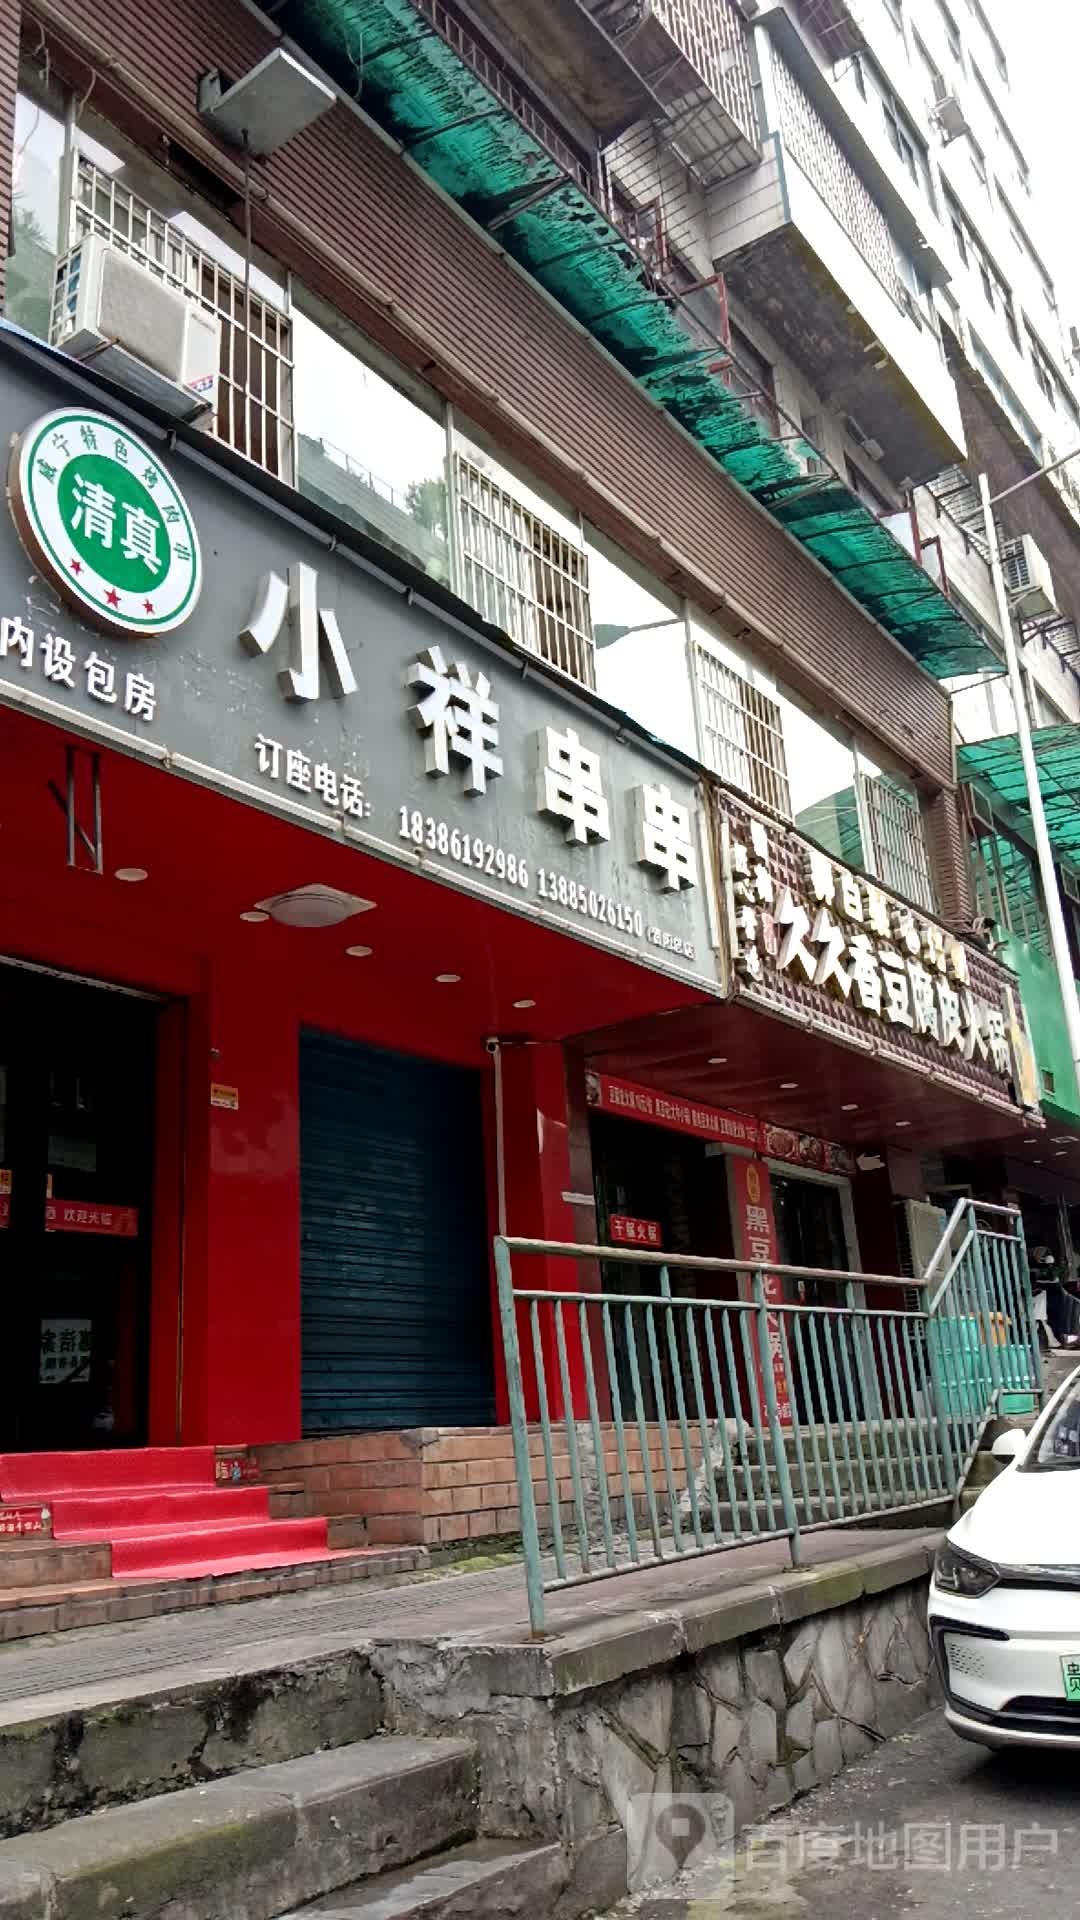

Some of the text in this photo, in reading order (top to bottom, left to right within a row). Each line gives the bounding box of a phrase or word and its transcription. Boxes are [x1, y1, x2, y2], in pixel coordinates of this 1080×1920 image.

[71, 473, 162, 575] 清真
[0, 615, 157, 721] 内设包房
[240, 561, 698, 892] 小祥串串
[399, 805, 529, 889] 18386192986
[538, 867, 643, 938] 13885026150
